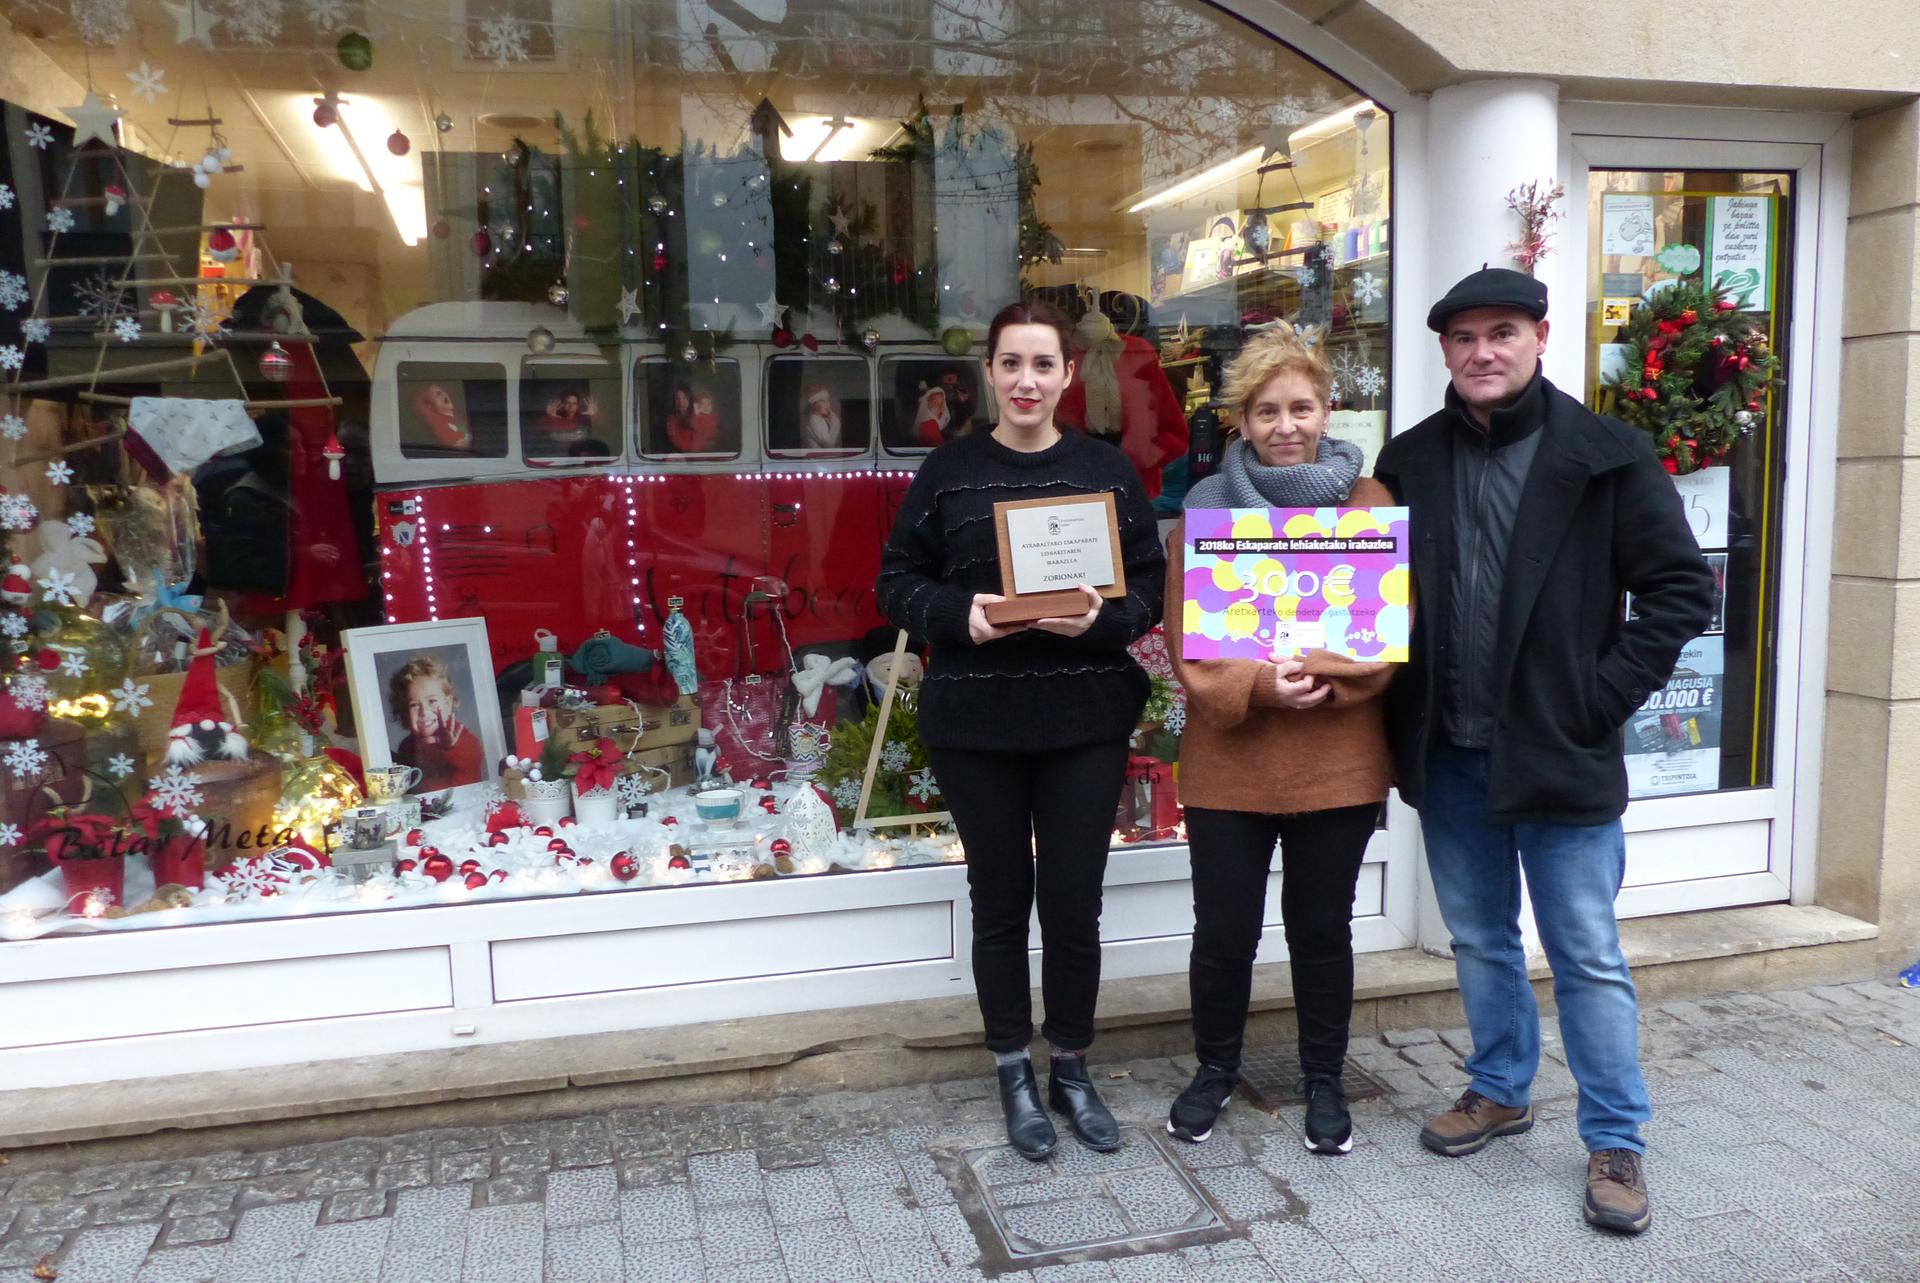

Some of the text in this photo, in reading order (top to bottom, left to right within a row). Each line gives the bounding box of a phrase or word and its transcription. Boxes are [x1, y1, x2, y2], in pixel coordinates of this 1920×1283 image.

[1200, 539, 1393, 552] 2018ko Eskaparate lehiaketako irabazlea
[1043, 572, 1086, 582] ZORIONAK!
[1238, 564, 1357, 603] 300€
[1667, 677, 1713, 690] NAGUSIA
[1703, 688, 1714, 706] €
[181, 819, 296, 861] Meta
